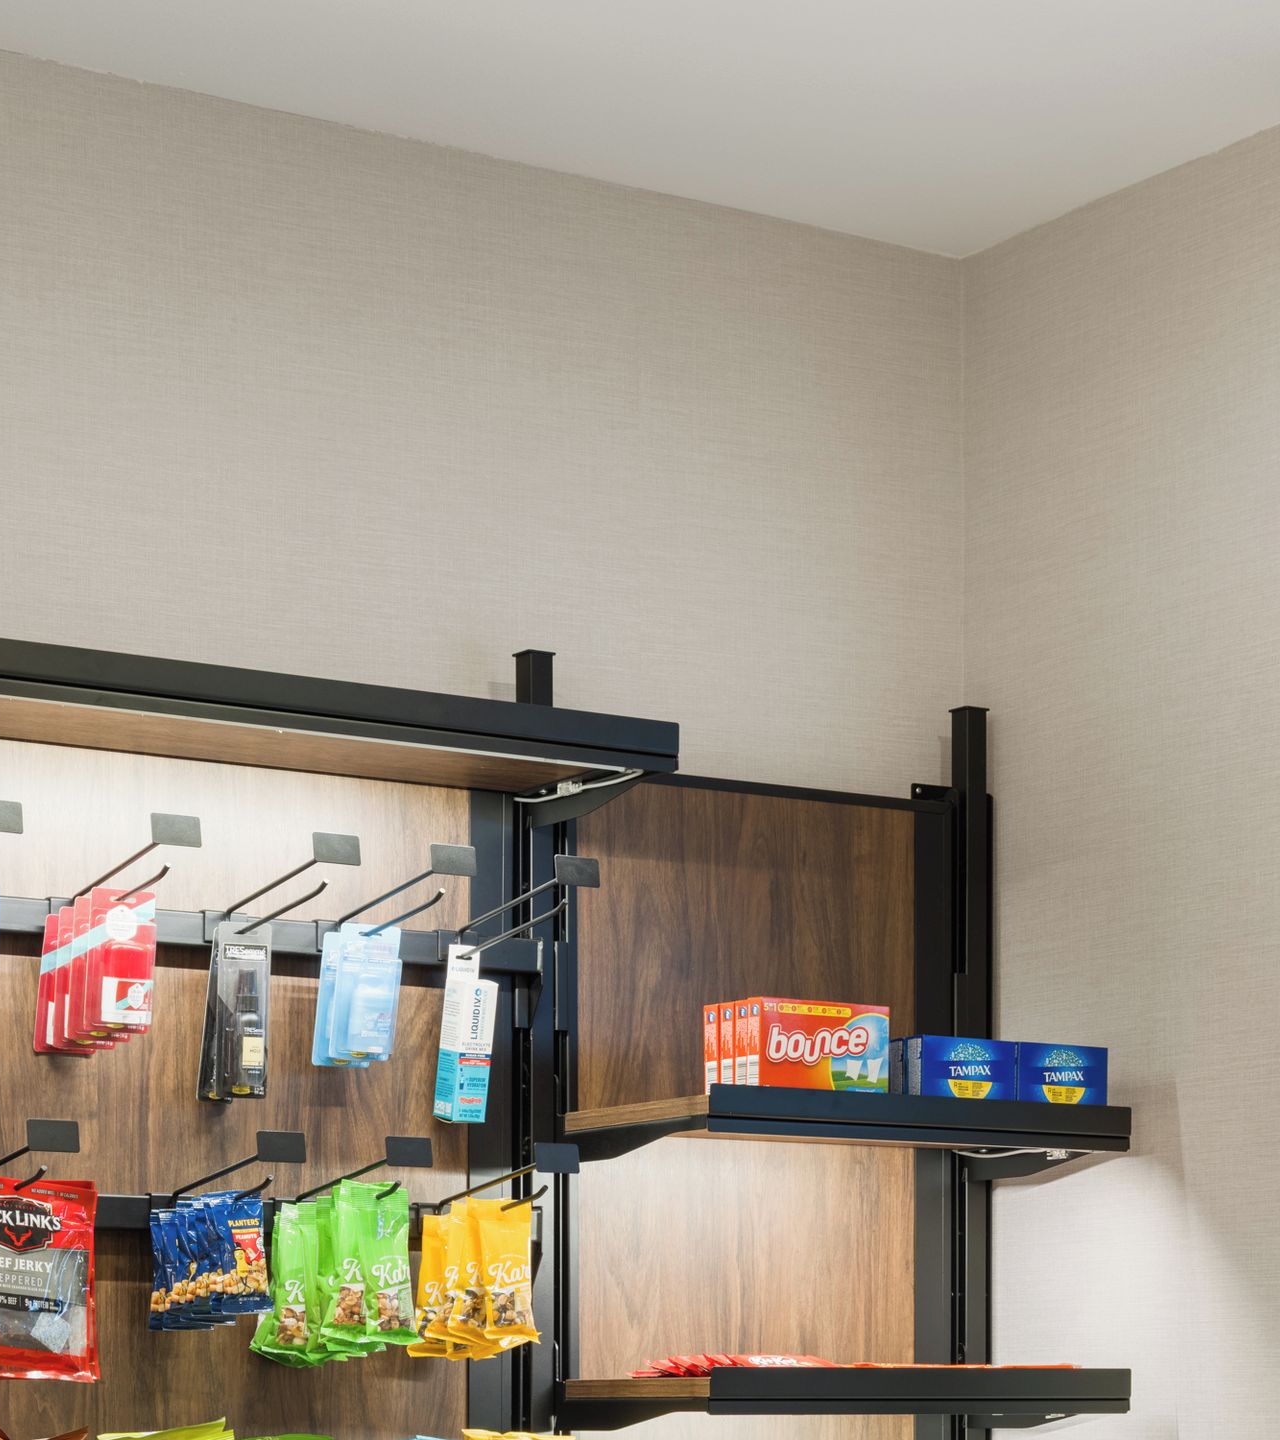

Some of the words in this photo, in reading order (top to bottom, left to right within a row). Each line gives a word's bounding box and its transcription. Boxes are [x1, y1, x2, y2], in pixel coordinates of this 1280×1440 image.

[767, 1024, 870, 1065] bounce
[948, 1064, 992, 1077] TAMPAX
[1043, 1070, 1084, 1083] TAMPAX
[15, 1211, 62, 1232] LINK'S
[228, 1218, 260, 1228] PLANTERS
[12, 1257, 53, 1274] JERKY
